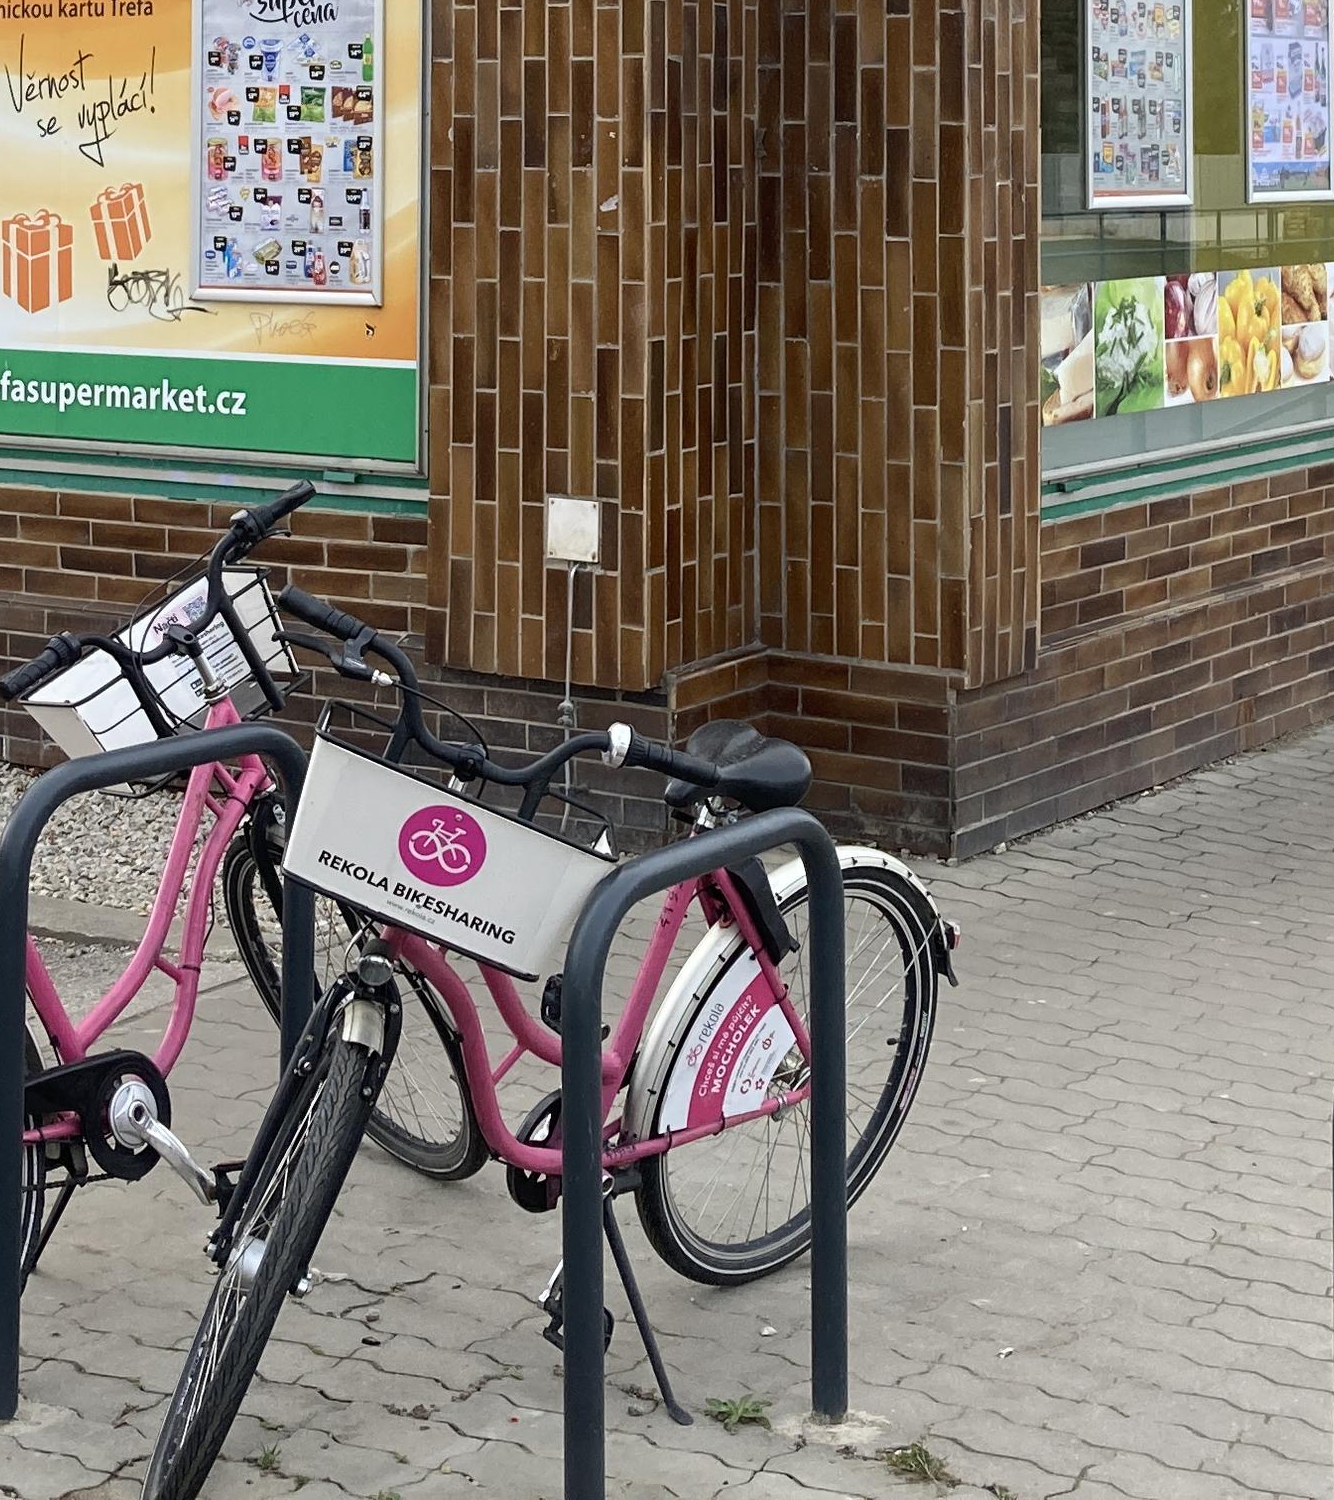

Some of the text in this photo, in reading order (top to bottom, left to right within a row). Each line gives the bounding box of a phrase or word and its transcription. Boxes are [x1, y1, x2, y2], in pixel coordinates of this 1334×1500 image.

[4, 33, 94, 113] Věrnost
[37, 116, 63, 137] se
[318, 850, 516, 945] REKOLA BIKESHARING
[699, 1003, 725, 1043] rekola
[711, 1003, 761, 1094] MOCHOLEK
